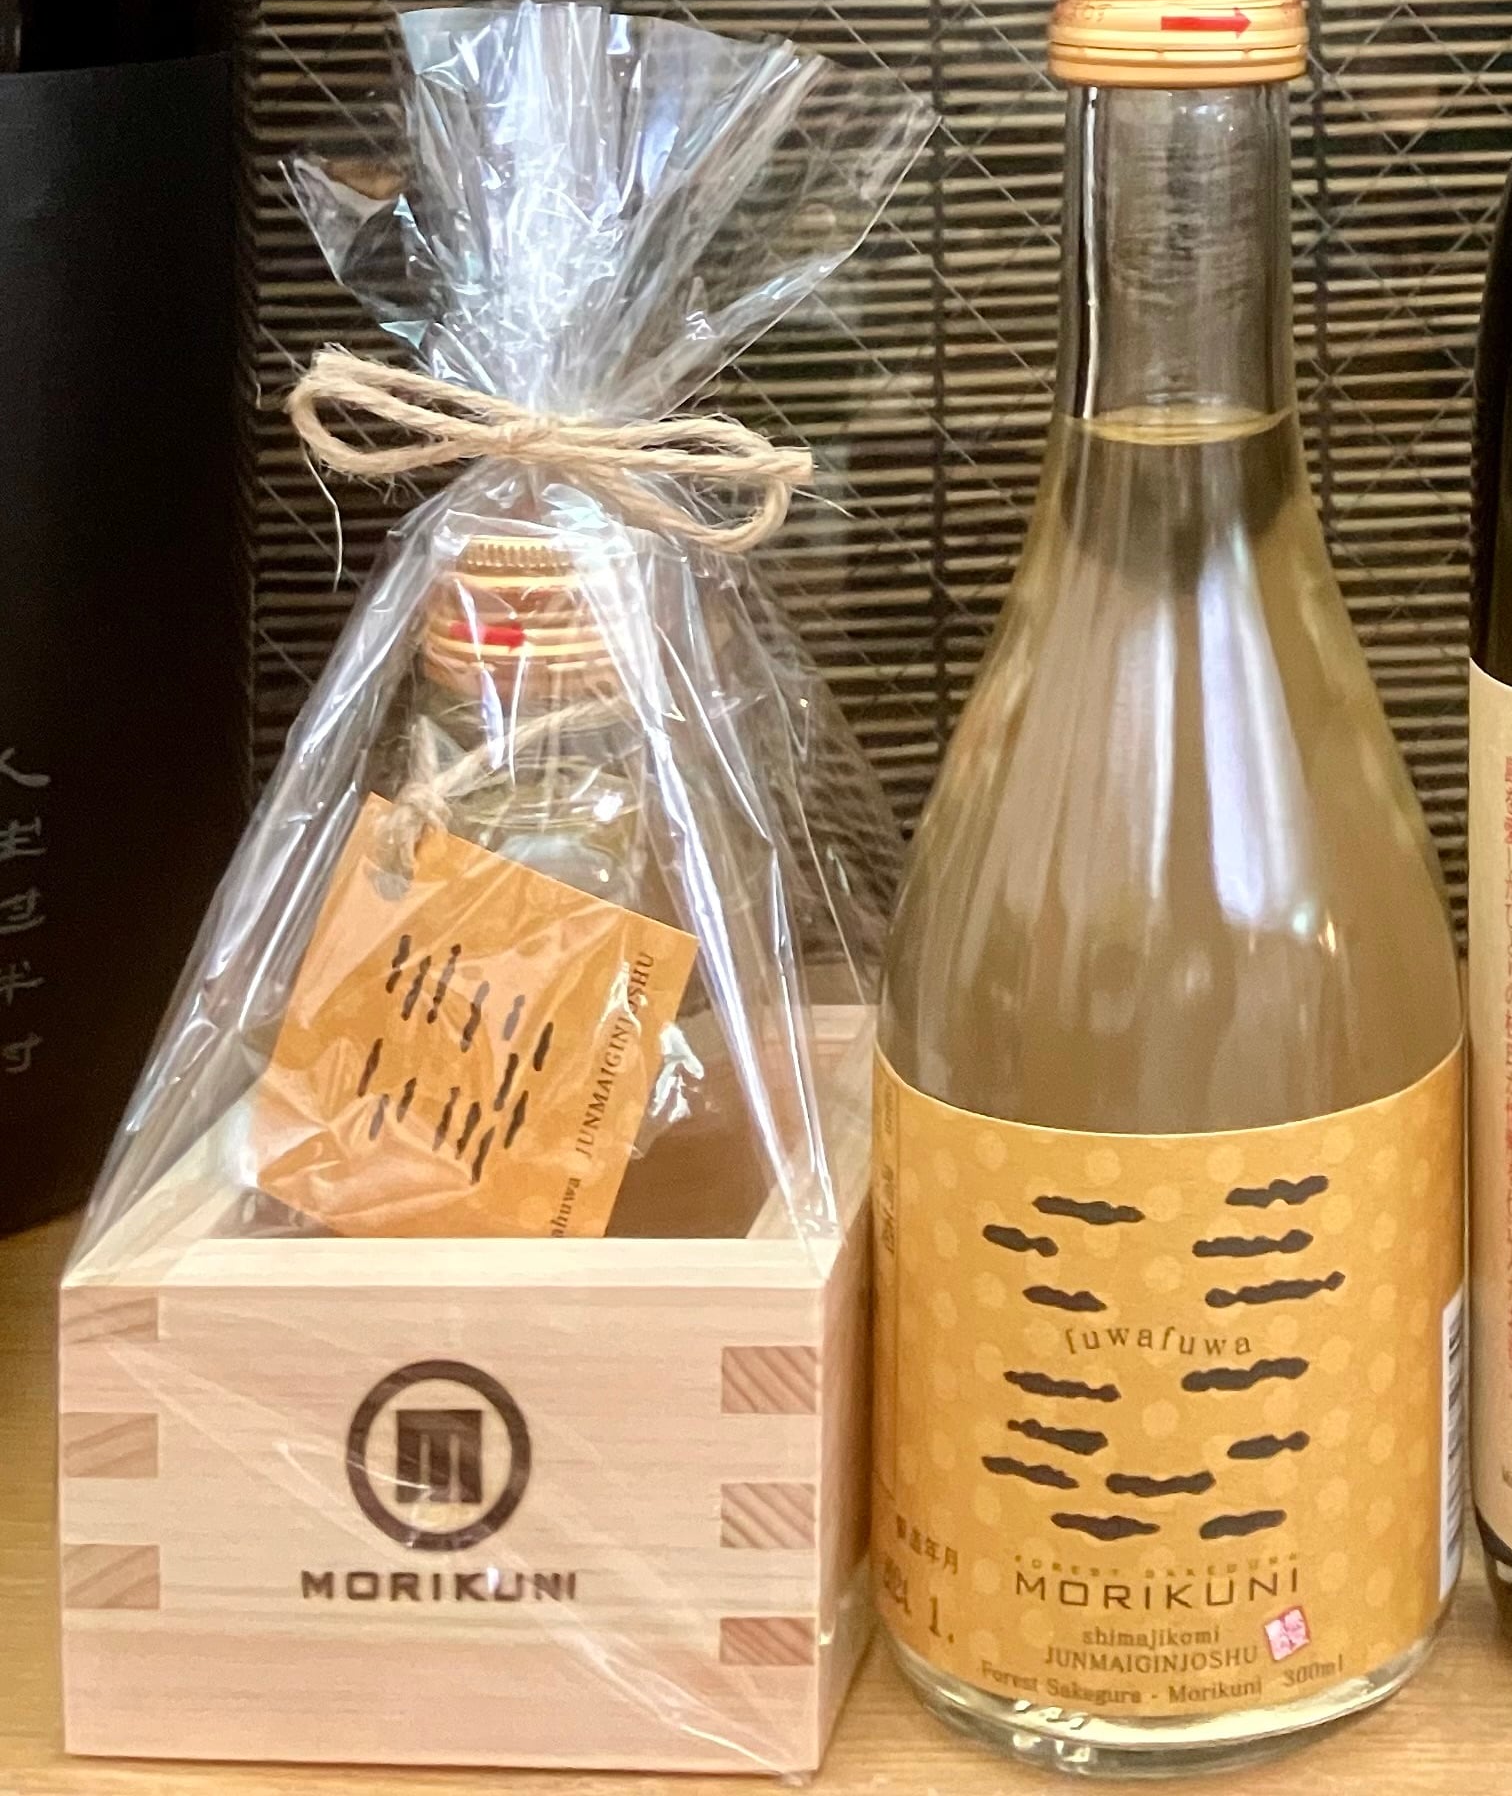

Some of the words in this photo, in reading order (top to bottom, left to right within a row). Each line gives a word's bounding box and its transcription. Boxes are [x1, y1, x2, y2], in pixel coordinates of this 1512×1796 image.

[1065, 1324, 1252, 1356] fuwafuwa
[301, 1569, 577, 1603] MORIKUNI
[1015, 1567, 1298, 1610] MORIKUNI
[1082, 1625, 1221, 1652] shimajikomi
[1045, 1644, 1258, 1675] JUNMAIGINJOSHU
[980, 1658, 1039, 1692] Forest
[1047, 1675, 1143, 1707] Sakegura
[1168, 1677, 1263, 1705] Morikuni
[1283, 1653, 1344, 1688] 300ml
